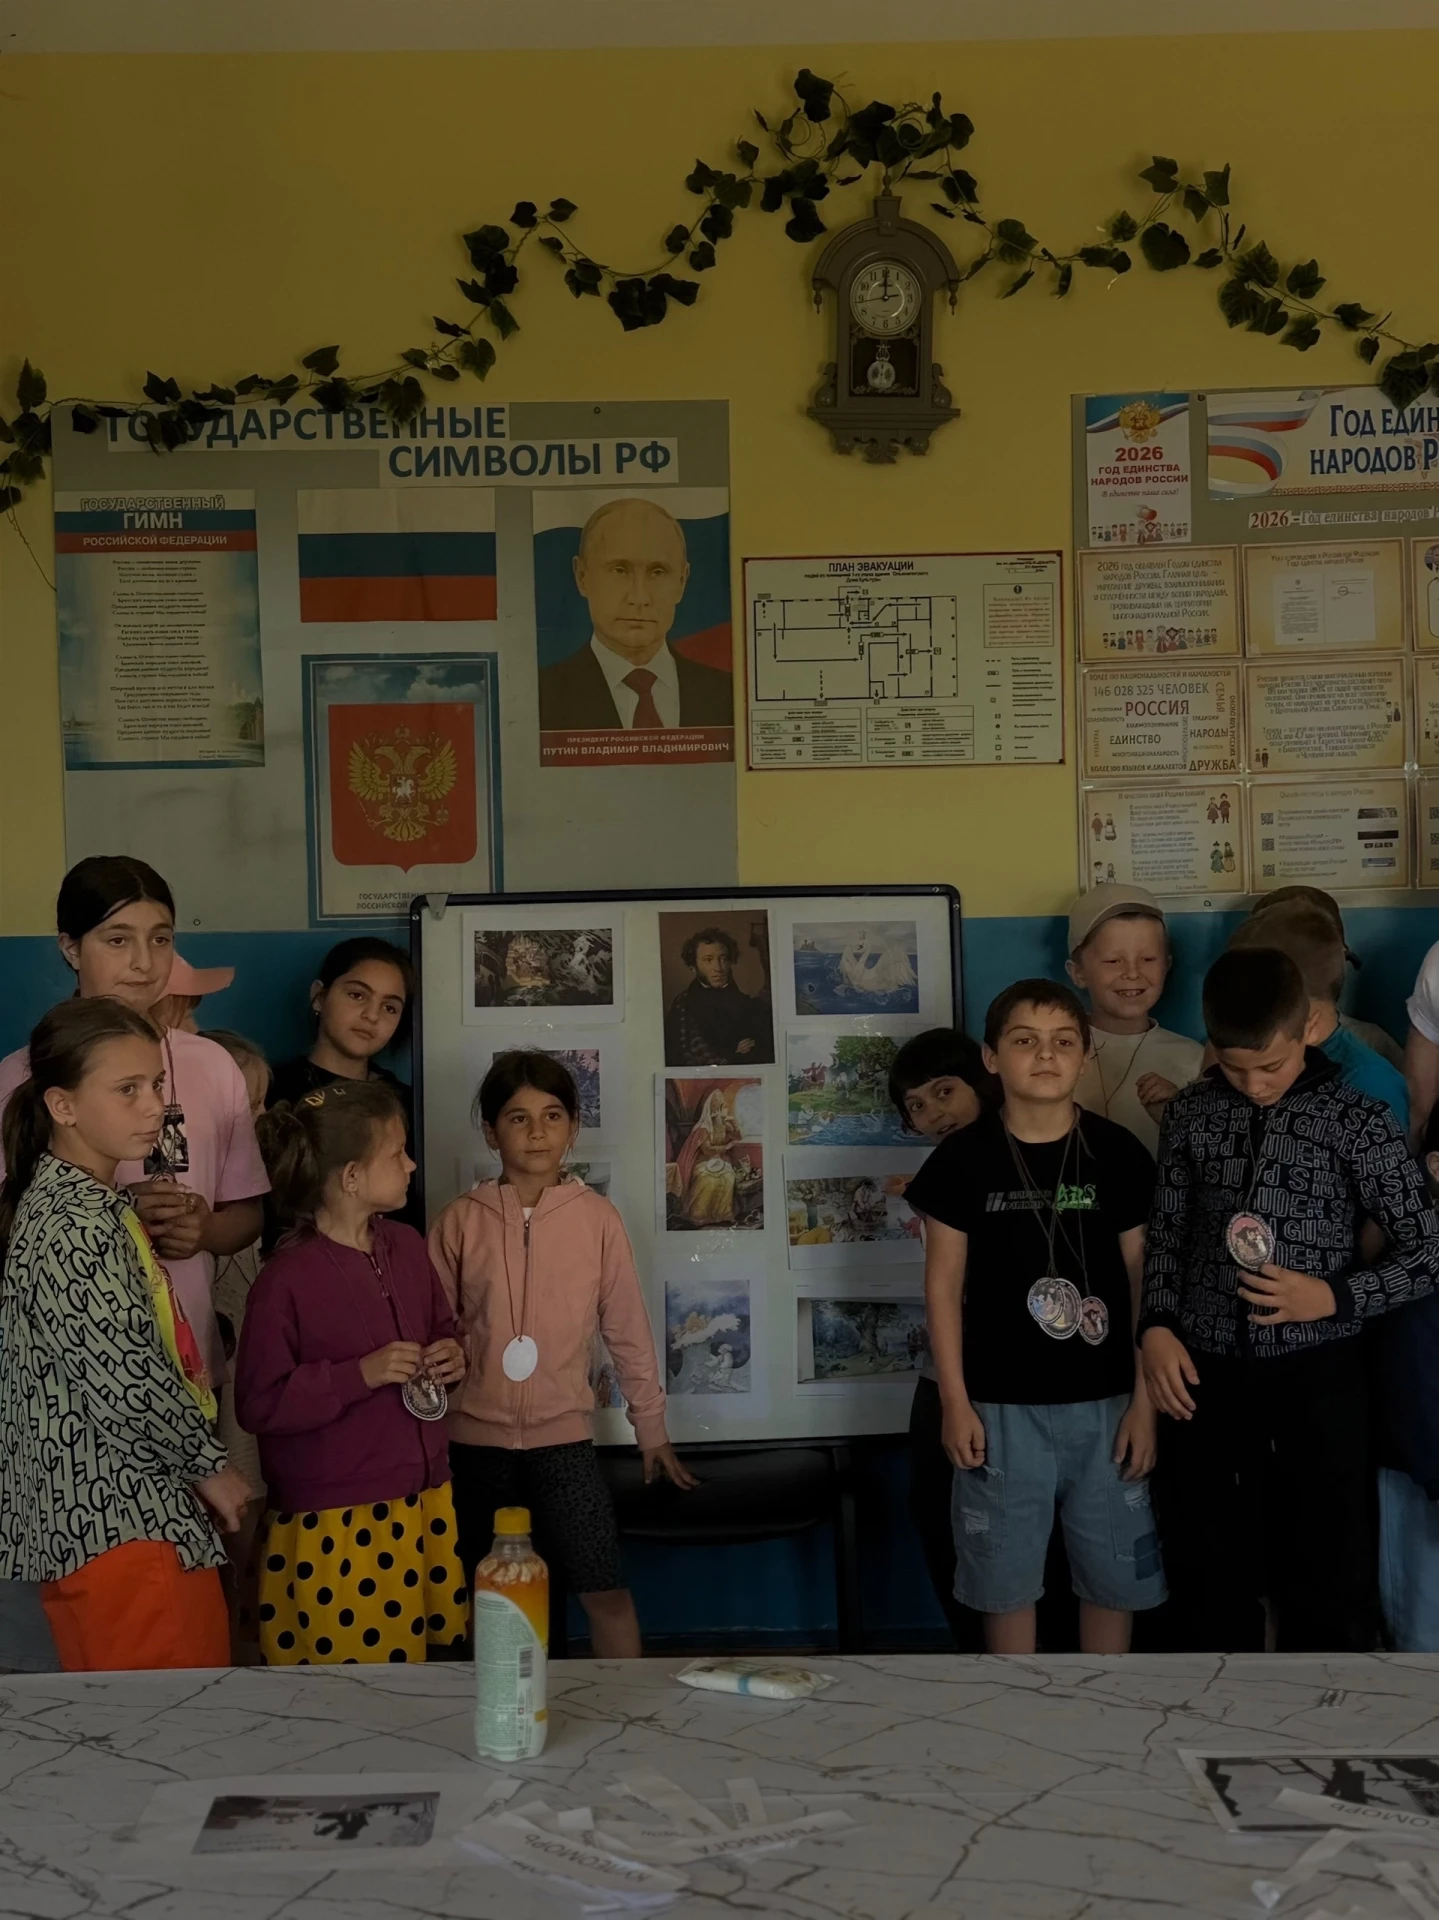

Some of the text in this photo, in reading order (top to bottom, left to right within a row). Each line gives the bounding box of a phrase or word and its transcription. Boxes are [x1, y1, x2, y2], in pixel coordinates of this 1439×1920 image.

[870, 272, 877, 281] 11
[861, 283, 869, 291] 10
[905, 282, 911, 290] 2
[858, 294, 864, 303] 9
[908, 294, 913, 303] 3
[861, 308, 868, 316] 8
[872, 317, 877, 326] 7
[883, 320, 888, 329] 6
[895, 317, 900, 325] 5
[110, 406, 505, 448] ГОУДАРСТВЕННЫЕ
[389, 440, 671, 477] СИМВОЛЫ РФ
[1115, 446, 1164, 462] 2026
[1310, 446, 1416, 475] НАРОДОВ
[1099, 464, 1180, 475] ГОД ЕДИНСТВА
[1091, 475, 1188, 486] НАРОДОВ РОССИИ
[80, 495, 226, 512] ГОСУДАРСТВЕННЫЙ
[123, 512, 183, 529] ГИМН
[1250, 511, 1289, 529] 2026
[1324, 511, 1376, 522] единства
[1384, 509, 1430, 522] народов
[83, 534, 227, 546] РОССИЙСКОЙ ФЕДЕРАЦИИ
[829, 561, 914, 572] ПЛАН ЭВАКУАЦИИ
[1097, 561, 1119, 571] 2026
[1093, 682, 1209, 697] 146 028 325 ЧЕЛОВЕК
[1215, 682, 1226, 713] СЕМЬЯ
[1125, 699, 1189, 717] РОССИЯ
[1190, 728, 1229, 738] НАРОДЫ
[1110, 734, 1161, 744] ЕДИНСТВО
[543, 743, 729, 756] ПУТИН ВЛАДИМИР ВЛАДИМИРОВИЧ
[1189, 759, 1237, 771] ДРУЖБА
[357, 901, 407, 909] РОССИЙСКОЙ
